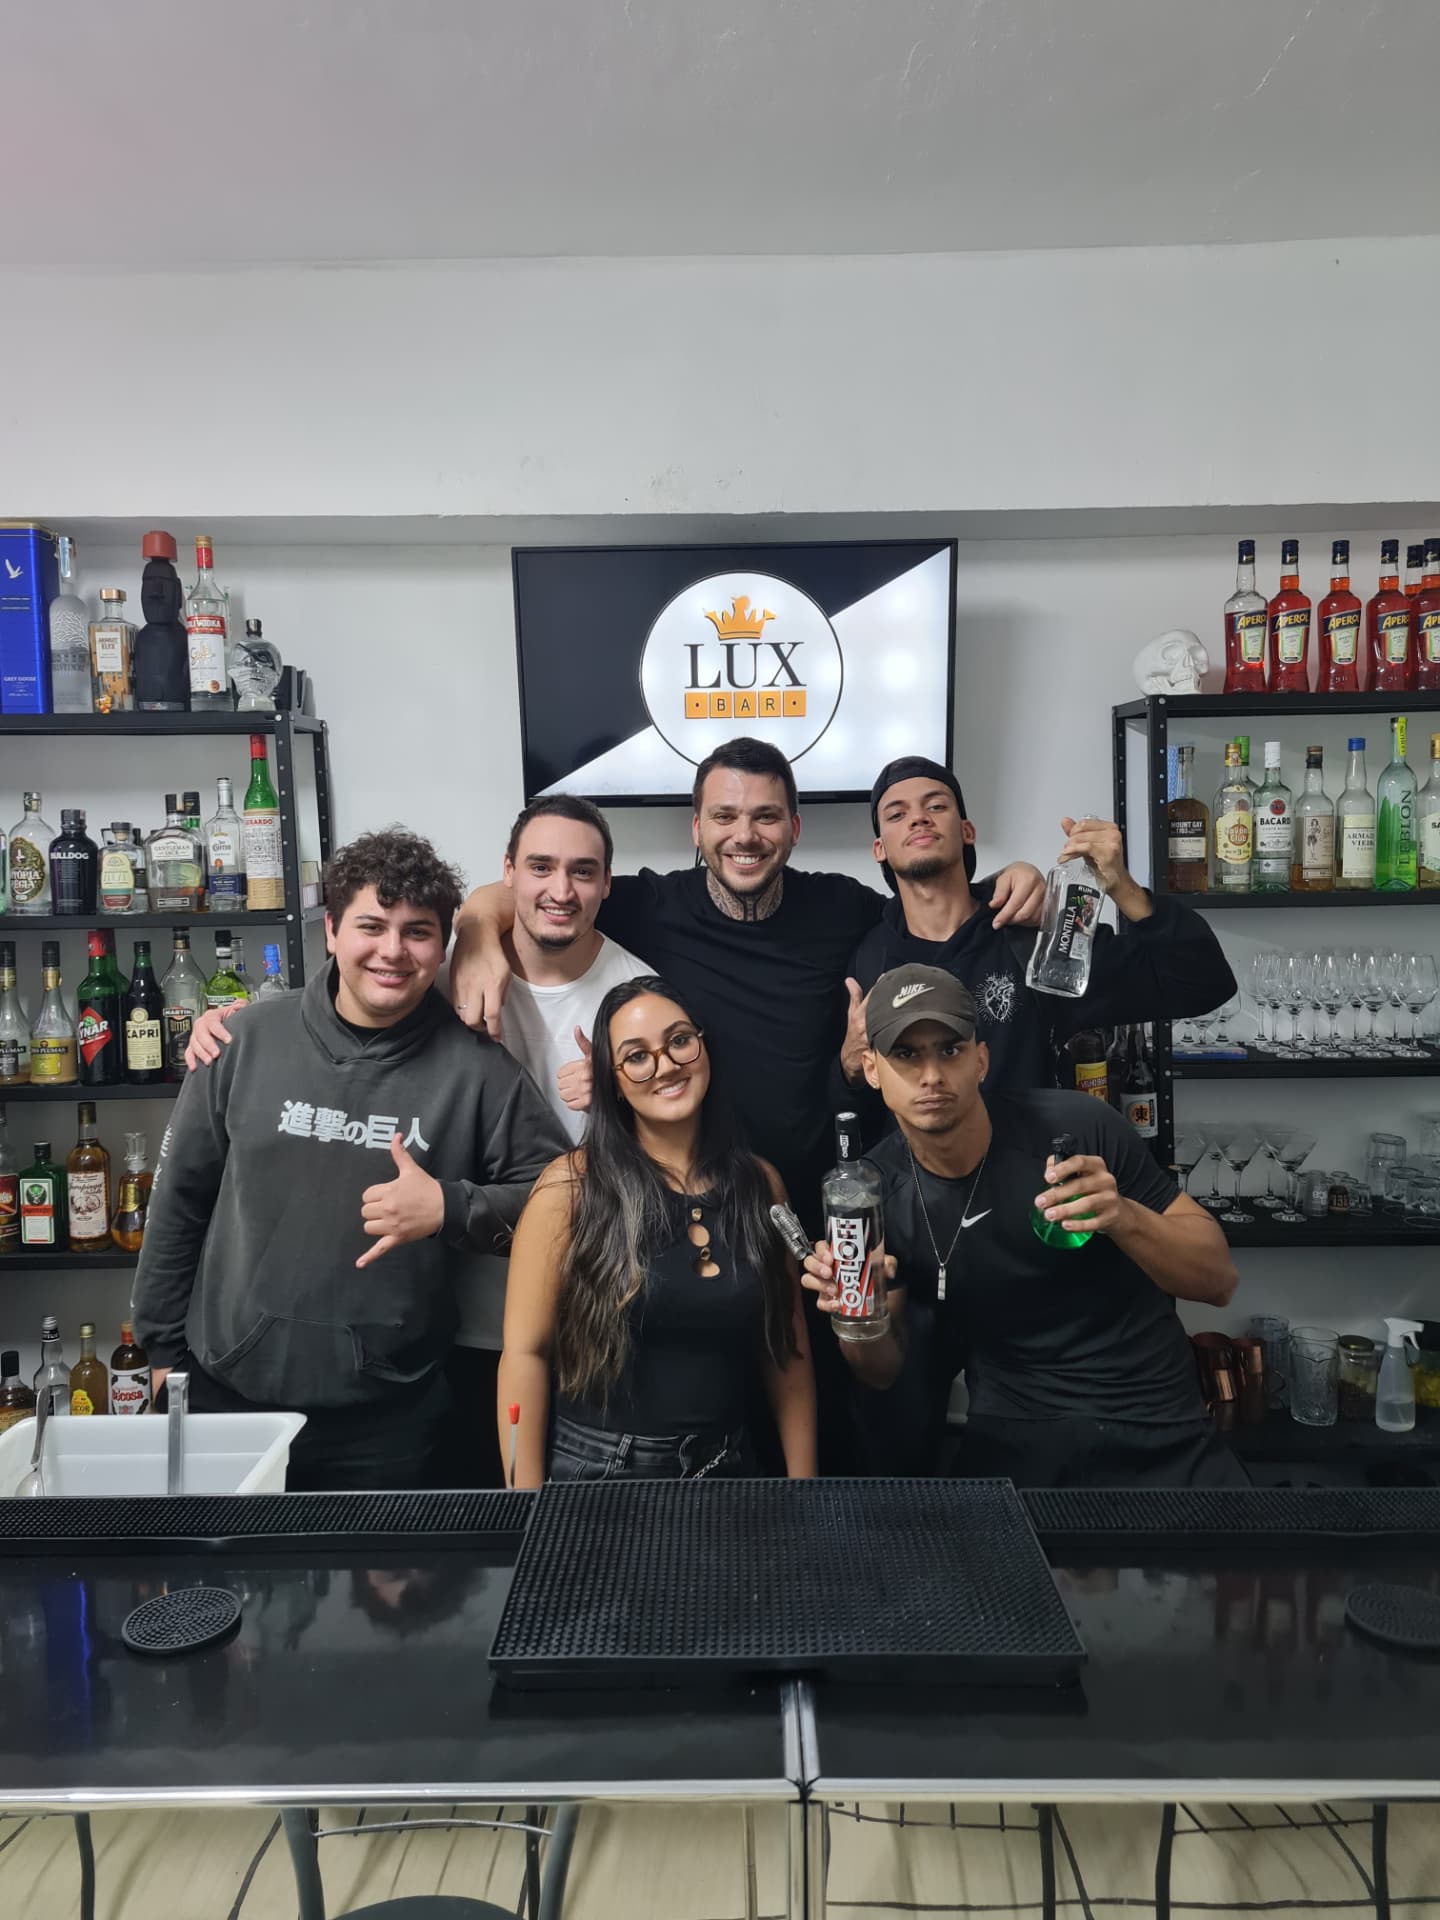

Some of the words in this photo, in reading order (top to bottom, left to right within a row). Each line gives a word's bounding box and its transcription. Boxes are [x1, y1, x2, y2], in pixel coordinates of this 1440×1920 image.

[1237, 614, 1266, 629] APERO
[1275, 613, 1309, 629] APEROL
[1328, 614, 1360, 630] APEROL
[1382, 615, 1409, 629] APER
[683, 641, 807, 688] LUX
[716, 697, 776, 712] BAR
[1260, 817, 1291, 825] BACARD
[1399, 790, 1412, 865] LEBLON
[1078, 885, 1093, 894] RUM
[1058, 906, 1077, 954] MONTILLA
[900, 983, 926, 997] NIKE
[278, 1100, 430, 1152] 進撃の巨人
[836, 1218, 863, 1308] ORLOFF
